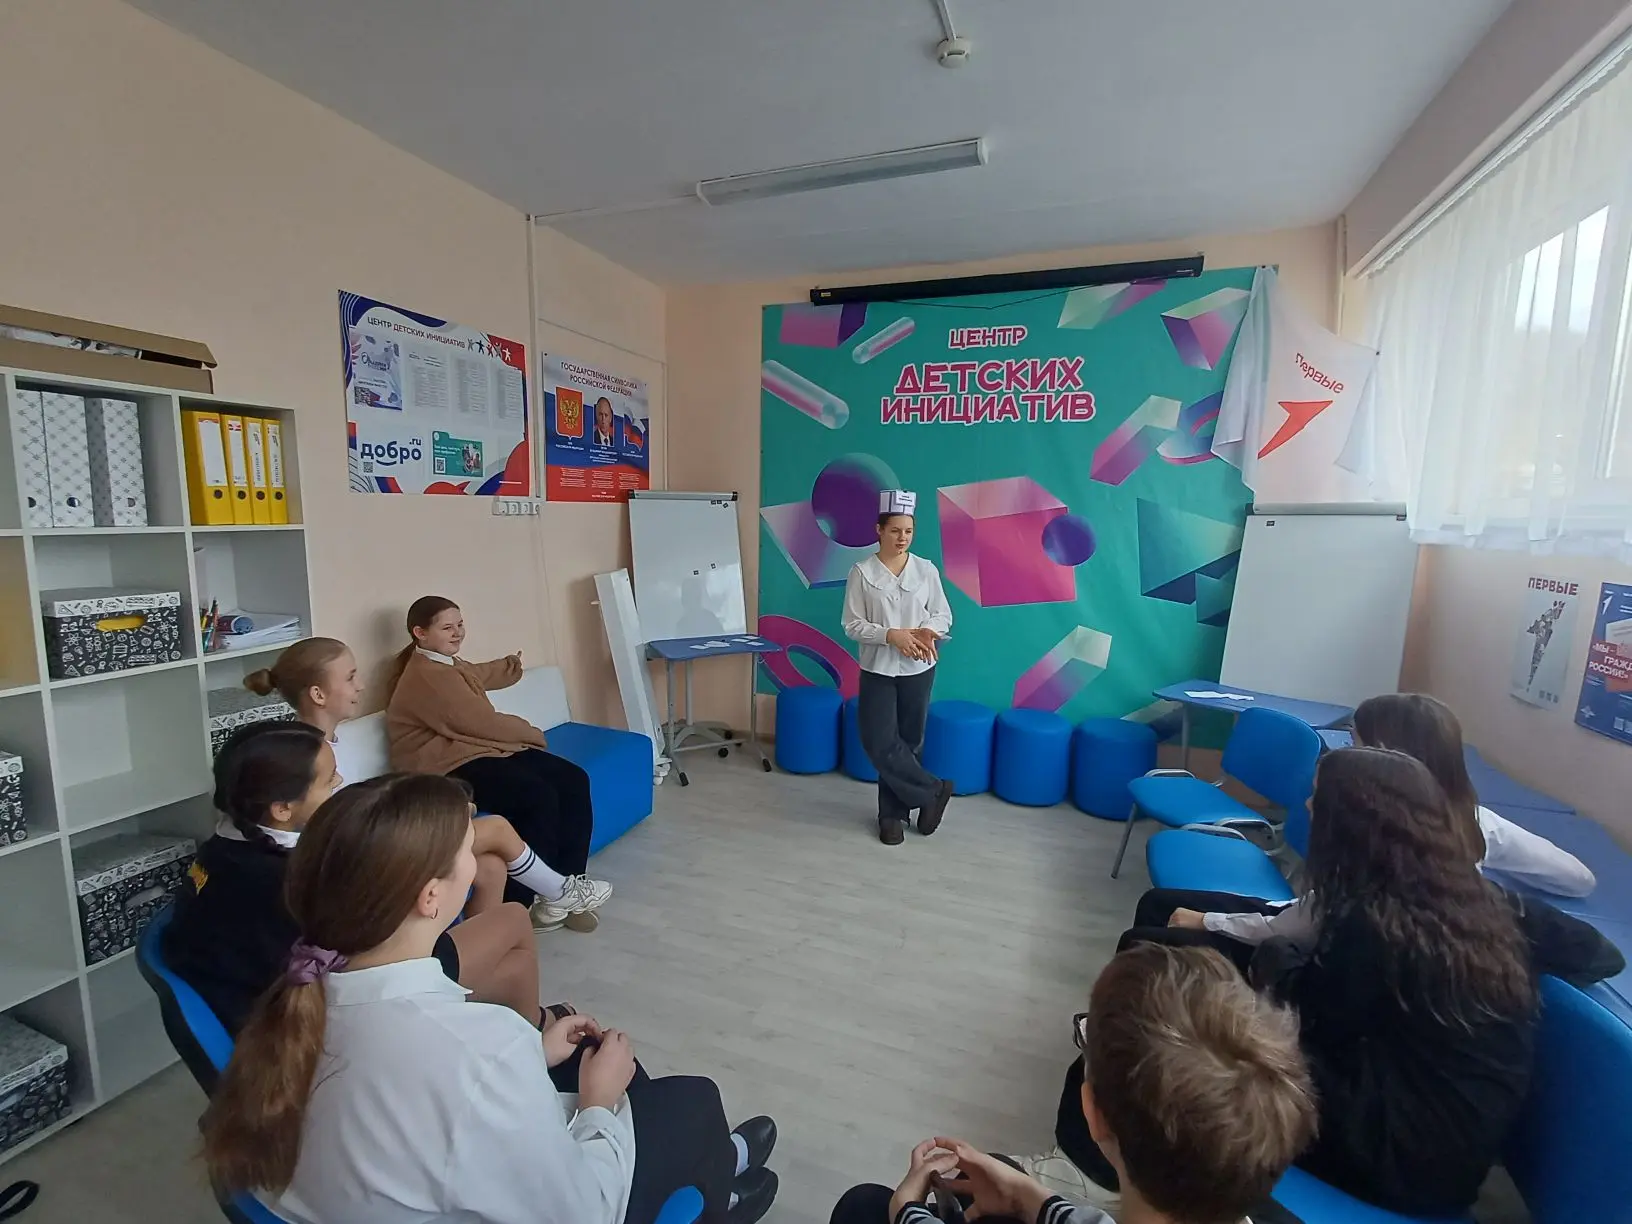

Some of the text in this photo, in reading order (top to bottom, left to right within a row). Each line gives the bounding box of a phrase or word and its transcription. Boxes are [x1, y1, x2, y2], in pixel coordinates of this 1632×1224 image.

[367, 316, 466, 349] ЦЕНТР ДЕТСКИХ ИНИЦИАТИВ
[949, 325, 1028, 350] ЦЕНТР
[561, 361, 611, 381] ГОСУДАРСТВЕННАЯ
[570, 374, 607, 390] РОССИЙСКОЙ
[894, 356, 1085, 396] ДЕТСКИХ
[881, 391, 1096, 426] ИНИЦИАТИВ
[360, 440, 422, 464] добро
[1528, 577, 1579, 596] ПЕРВЫЕ
